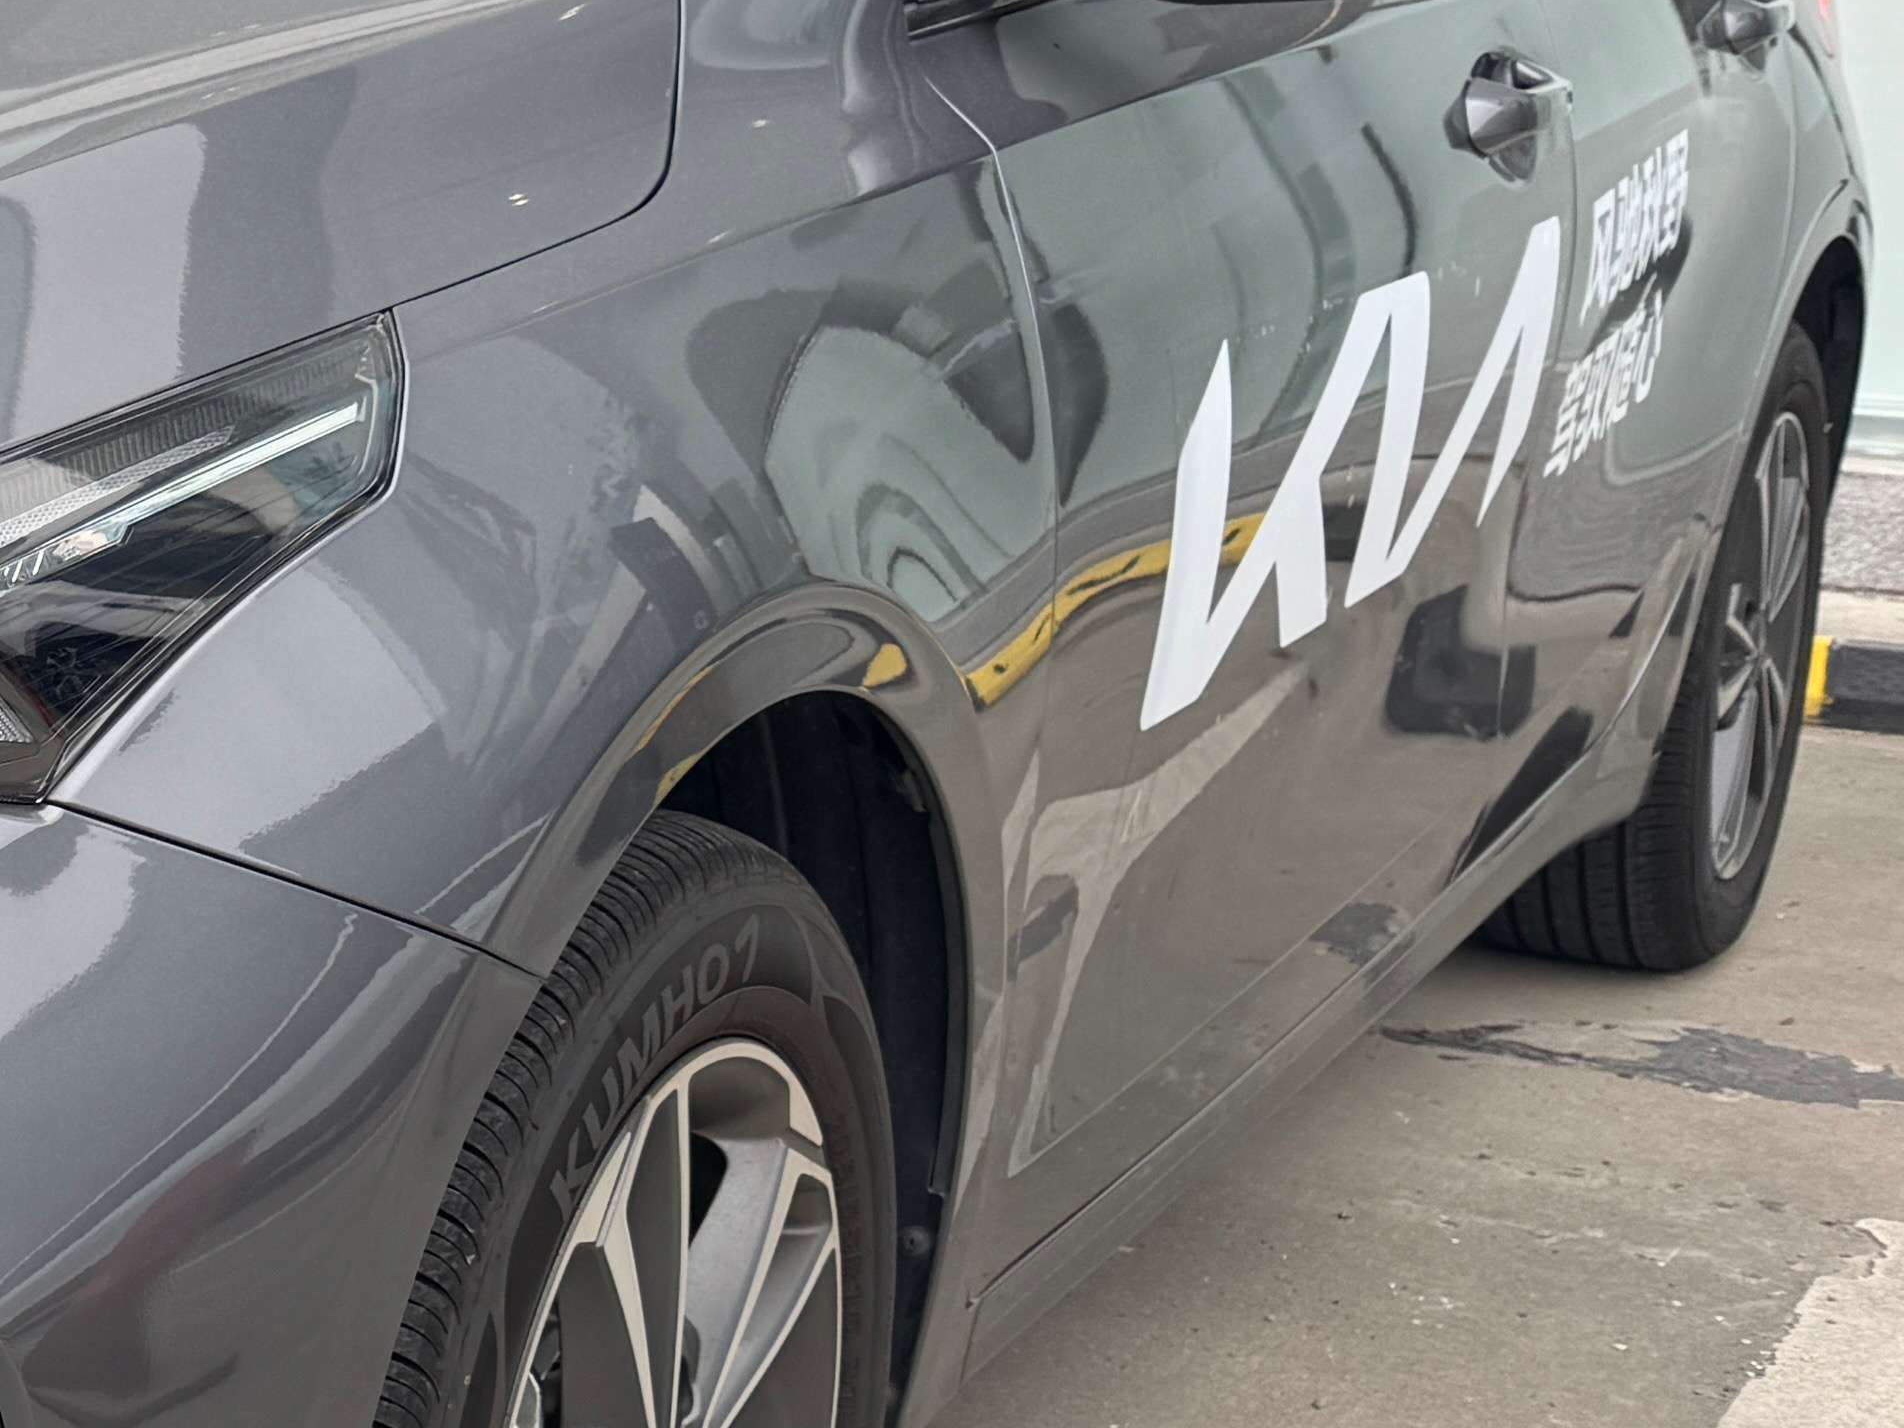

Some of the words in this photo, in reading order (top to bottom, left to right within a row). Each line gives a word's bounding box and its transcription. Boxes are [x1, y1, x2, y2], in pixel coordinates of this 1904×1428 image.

[1579, 128, 1689, 326] 风驰秋野
[1140, 216, 1560, 731] KIA
[549, 942, 729, 1224] KUMHO
